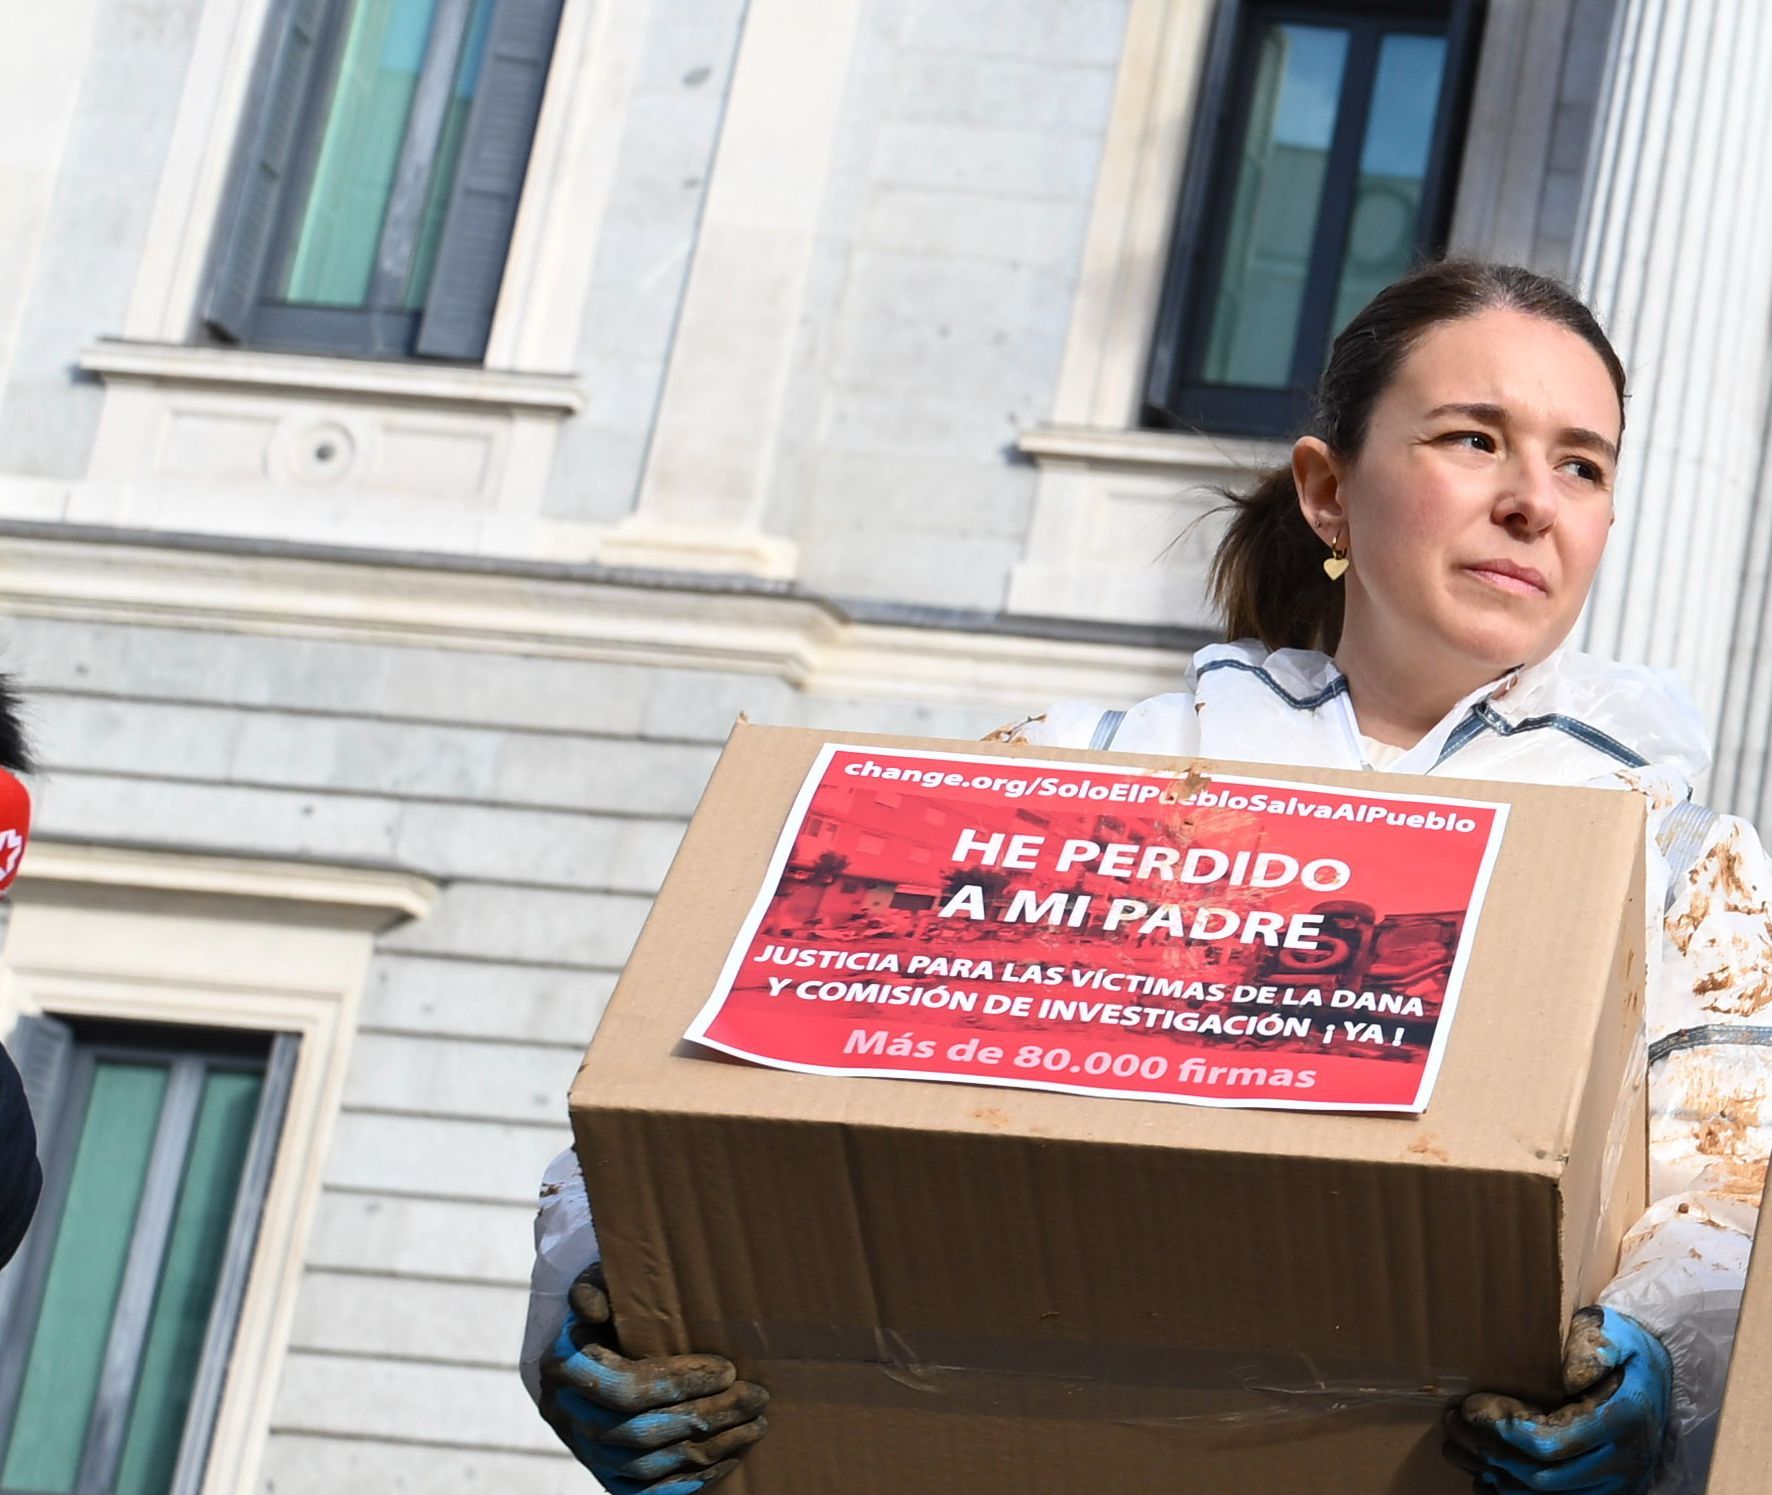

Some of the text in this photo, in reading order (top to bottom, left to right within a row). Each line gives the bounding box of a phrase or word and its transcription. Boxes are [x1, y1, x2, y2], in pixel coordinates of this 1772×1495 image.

[951, 828, 1351, 892] HE PERDIDO
[937, 884, 1325, 950] A MI PADRE
[753, 944, 1424, 1017] JUSTICIA PARA LAS VÍCTIMAS DE LA DANA
[768, 976, 793, 997] Y
[796, 980, 978, 1012] COMISIÓN
[982, 994, 1034, 1017] DE
[1037, 998, 1312, 1038] INVESTIGACIÓN
[843, 1029, 1317, 1089] Más de 80.000 firmas
